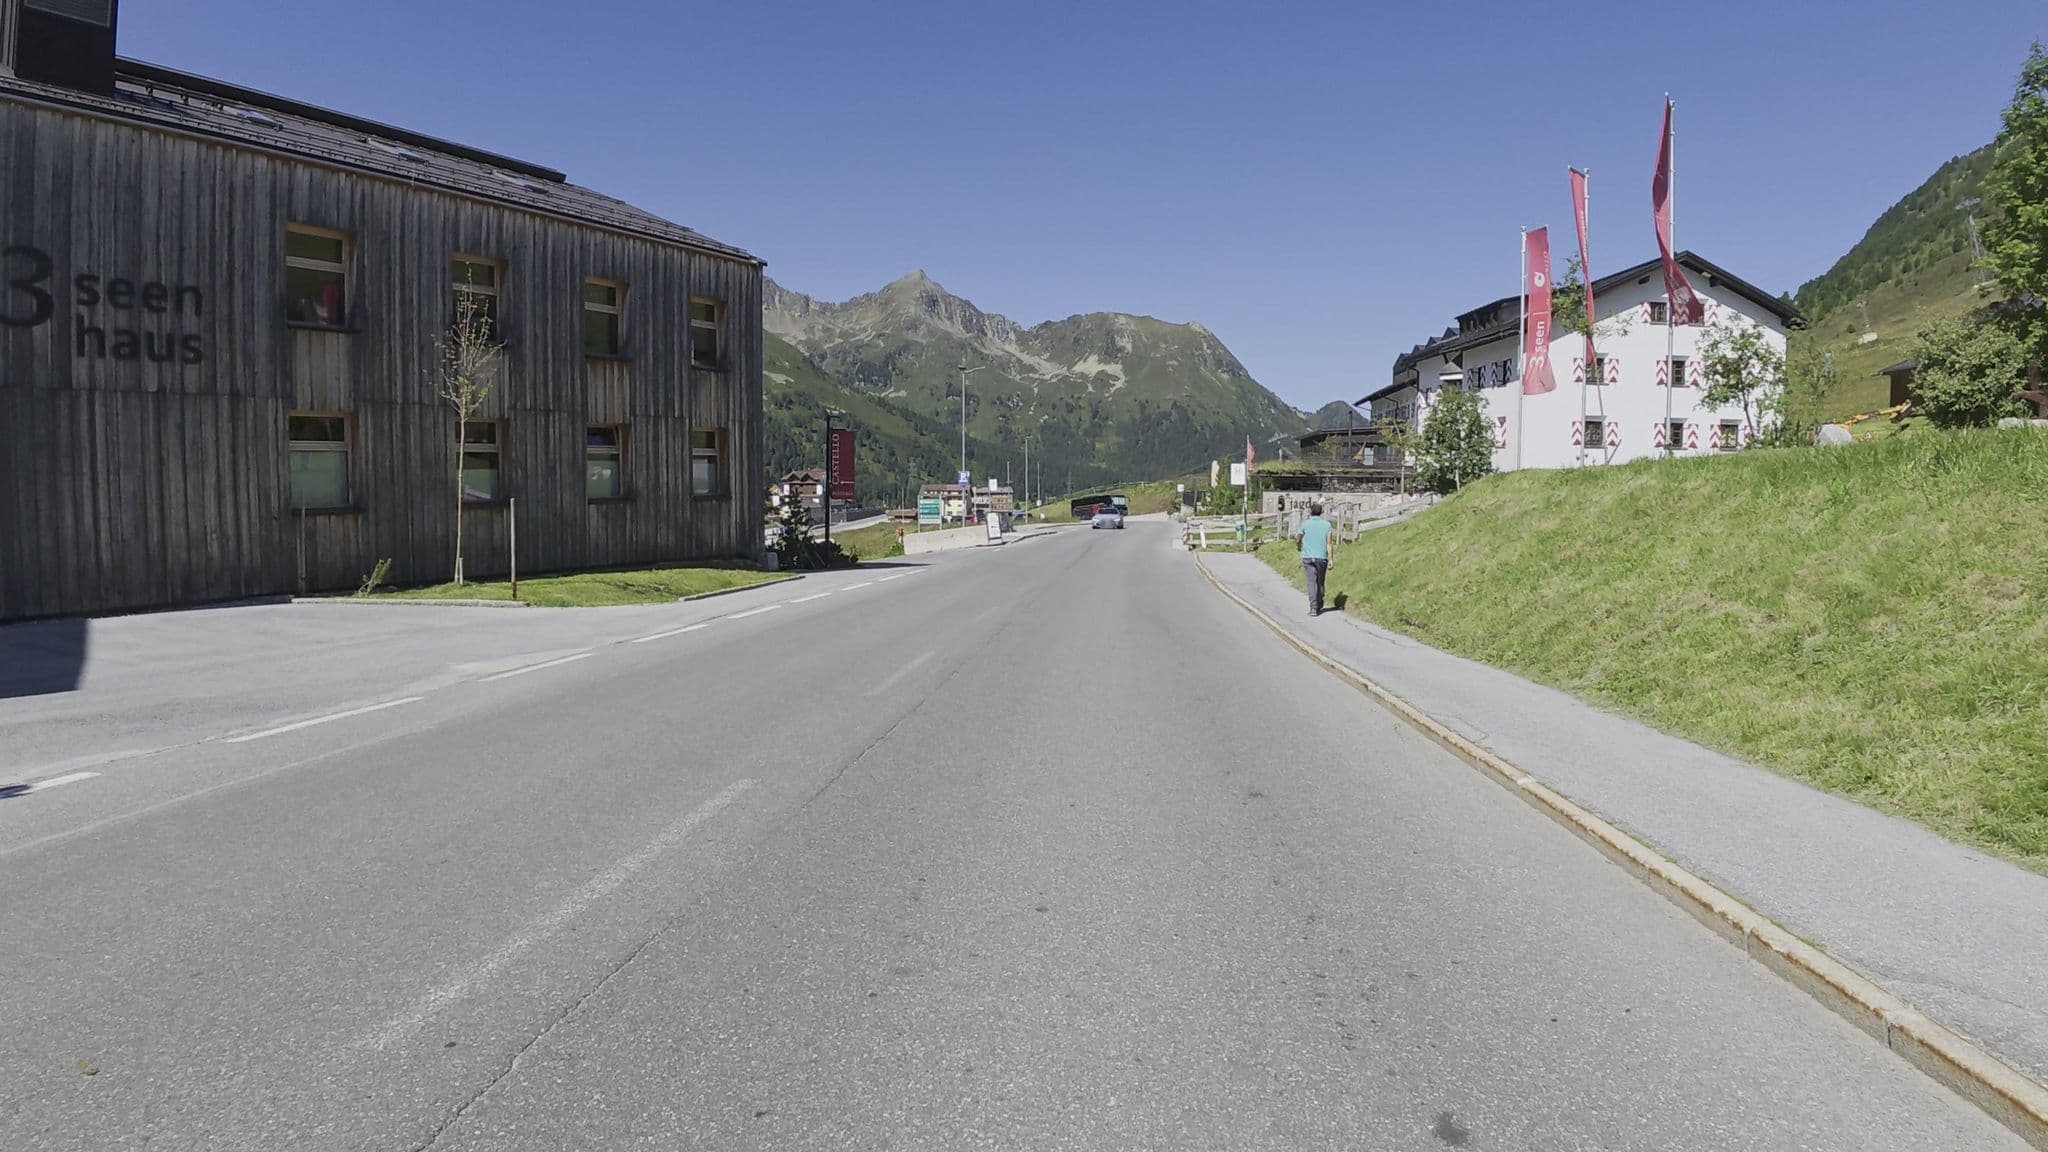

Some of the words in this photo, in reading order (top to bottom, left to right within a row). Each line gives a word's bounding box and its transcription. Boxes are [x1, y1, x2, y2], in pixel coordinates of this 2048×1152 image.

[0, 246, 53, 327] 3
[76, 274, 203, 317] seen
[76, 313, 203, 364] haus
[1535, 321, 1545, 353] seen
[1530, 355, 1545, 368] 3
